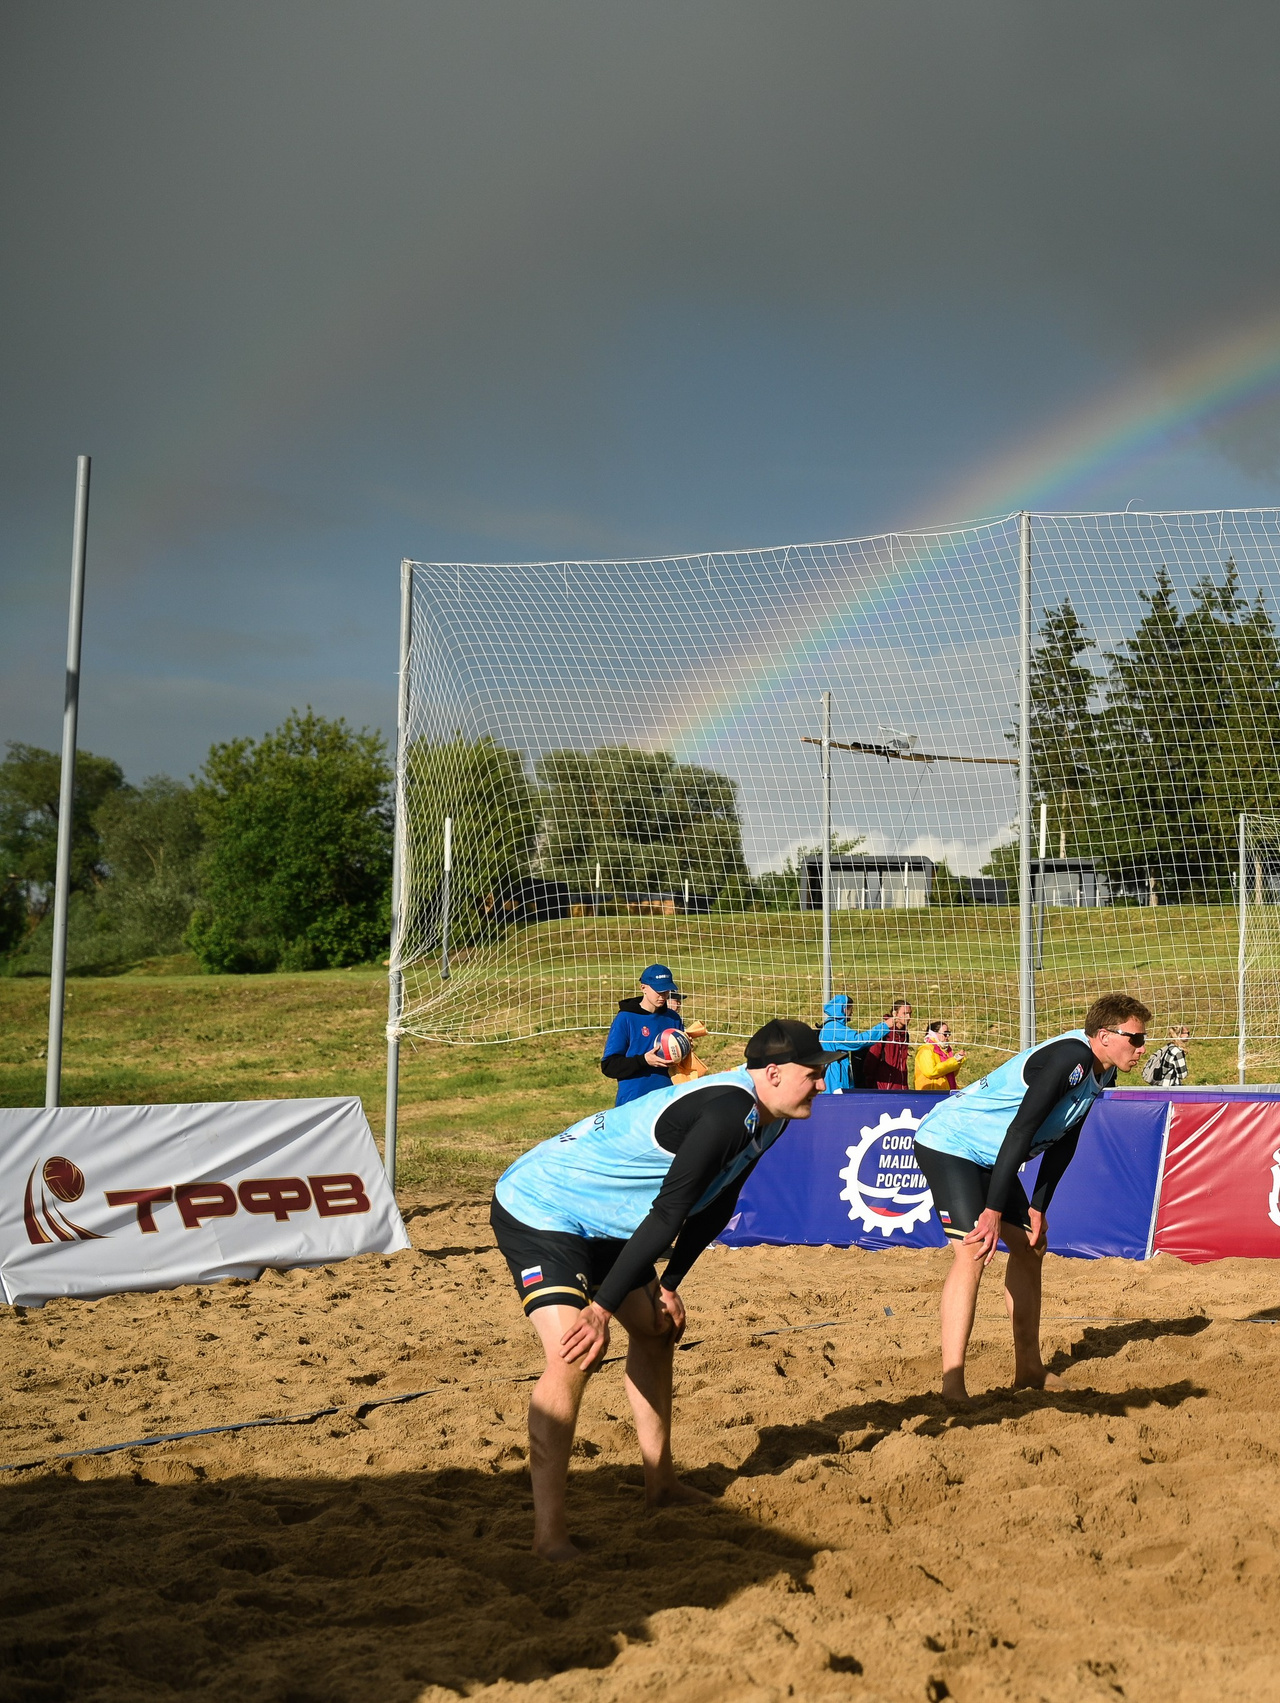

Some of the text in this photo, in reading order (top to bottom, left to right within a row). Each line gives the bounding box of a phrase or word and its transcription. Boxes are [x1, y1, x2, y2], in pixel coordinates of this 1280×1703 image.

[882, 1135, 915, 1150] СОЮ
[875, 1172, 928, 1188] РОССИИ
[103, 1172, 372, 1235] ТРФВ
